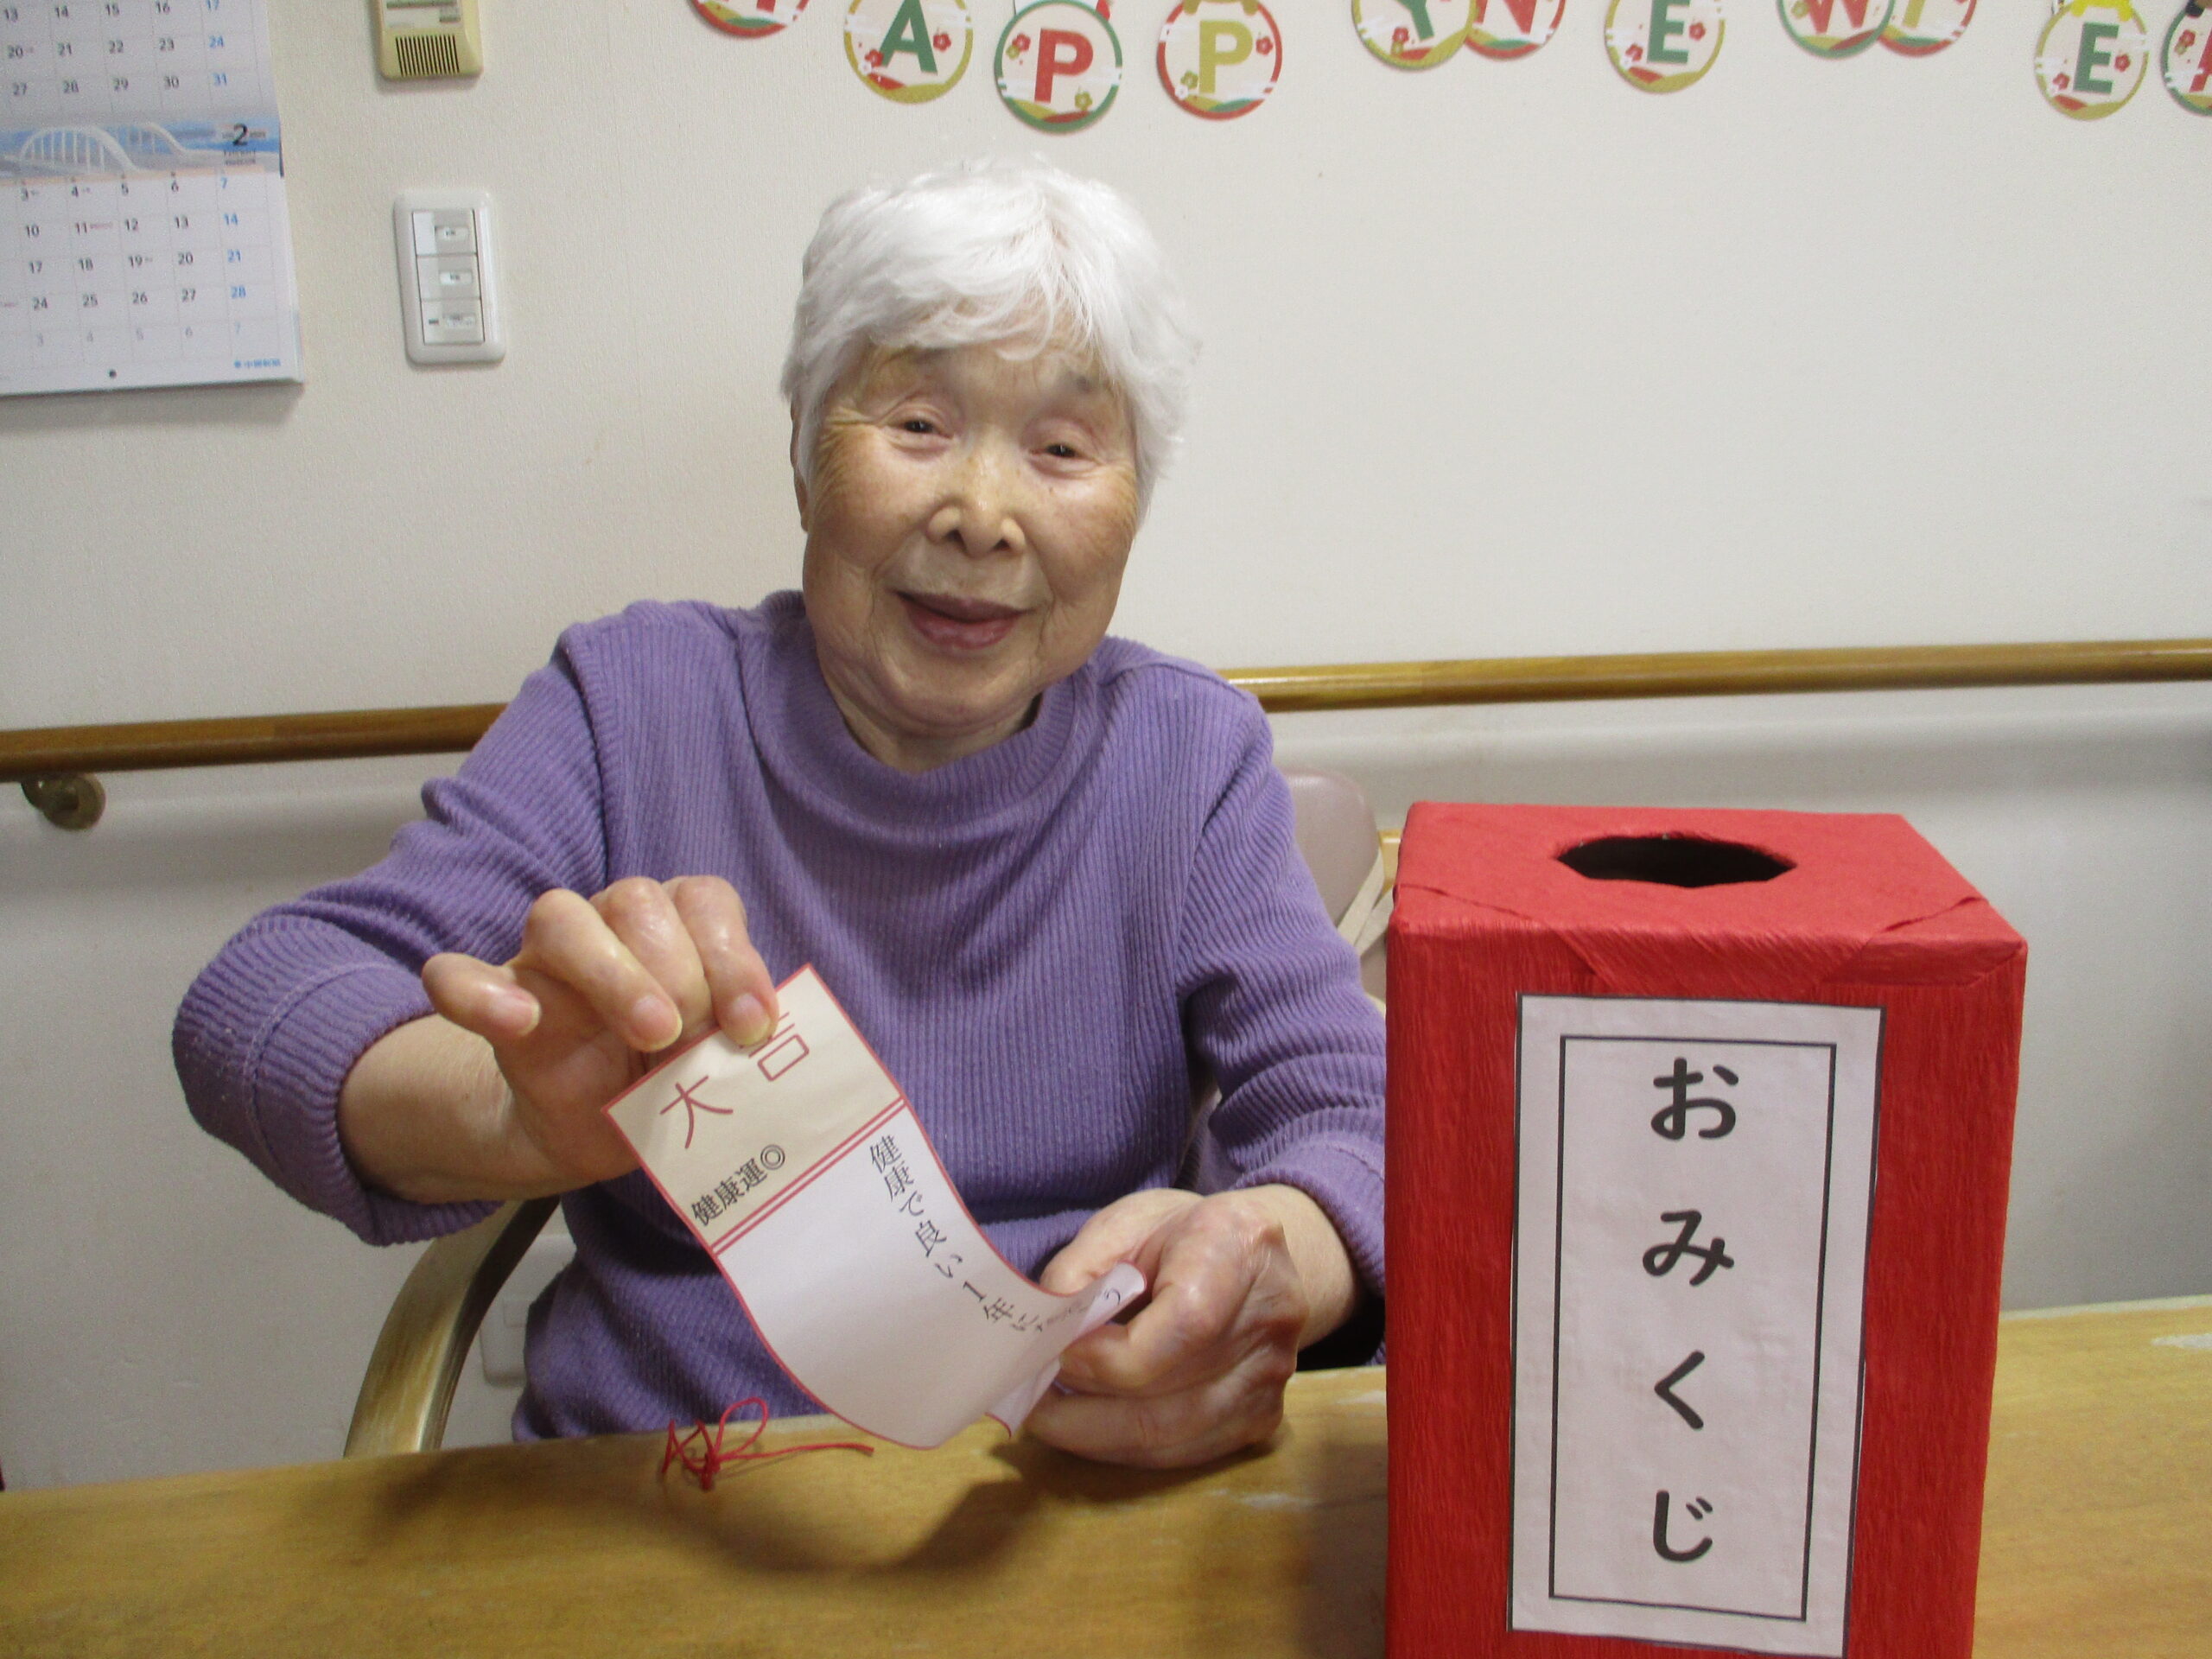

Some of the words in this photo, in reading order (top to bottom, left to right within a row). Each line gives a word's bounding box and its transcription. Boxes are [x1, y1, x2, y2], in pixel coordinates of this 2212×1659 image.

[8, 44, 23, 59] 20
[58, 42, 72, 56] 21
[109, 40, 124, 54] 22
[159, 37, 174, 52] 23
[209, 35, 224, 48] 24
[13, 82, 27, 96] 27
[63, 79, 79, 93] 28
[113, 77, 129, 92] 29
[164, 75, 179, 88] 30
[213, 73, 227, 86] 31
[232, 123, 249, 147] 2
[22, 188, 29, 201] 3
[71, 186, 79, 198] 4
[121, 183, 129, 195] 5
[171, 181, 179, 193] 6
[220, 177, 228, 189] 7
[26, 224, 40, 238] 10
[76, 221, 87, 235] 11
[125, 218, 138, 232] 12
[175, 215, 189, 229] 13
[224, 213, 238, 226] 14
[29, 261, 42, 274] 17
[79, 257, 93, 271] 18
[128, 255, 143, 269] 19
[178, 251, 194, 265] 20
[228, 249, 241, 263] 21
[33, 296, 48, 310] 24
[83, 294, 98, 308] 25
[132, 291, 148, 304] 26
[181, 289, 196, 302] 27
[231, 285, 246, 300] 28
[1643, 1057, 1739, 1563] おみくじ
